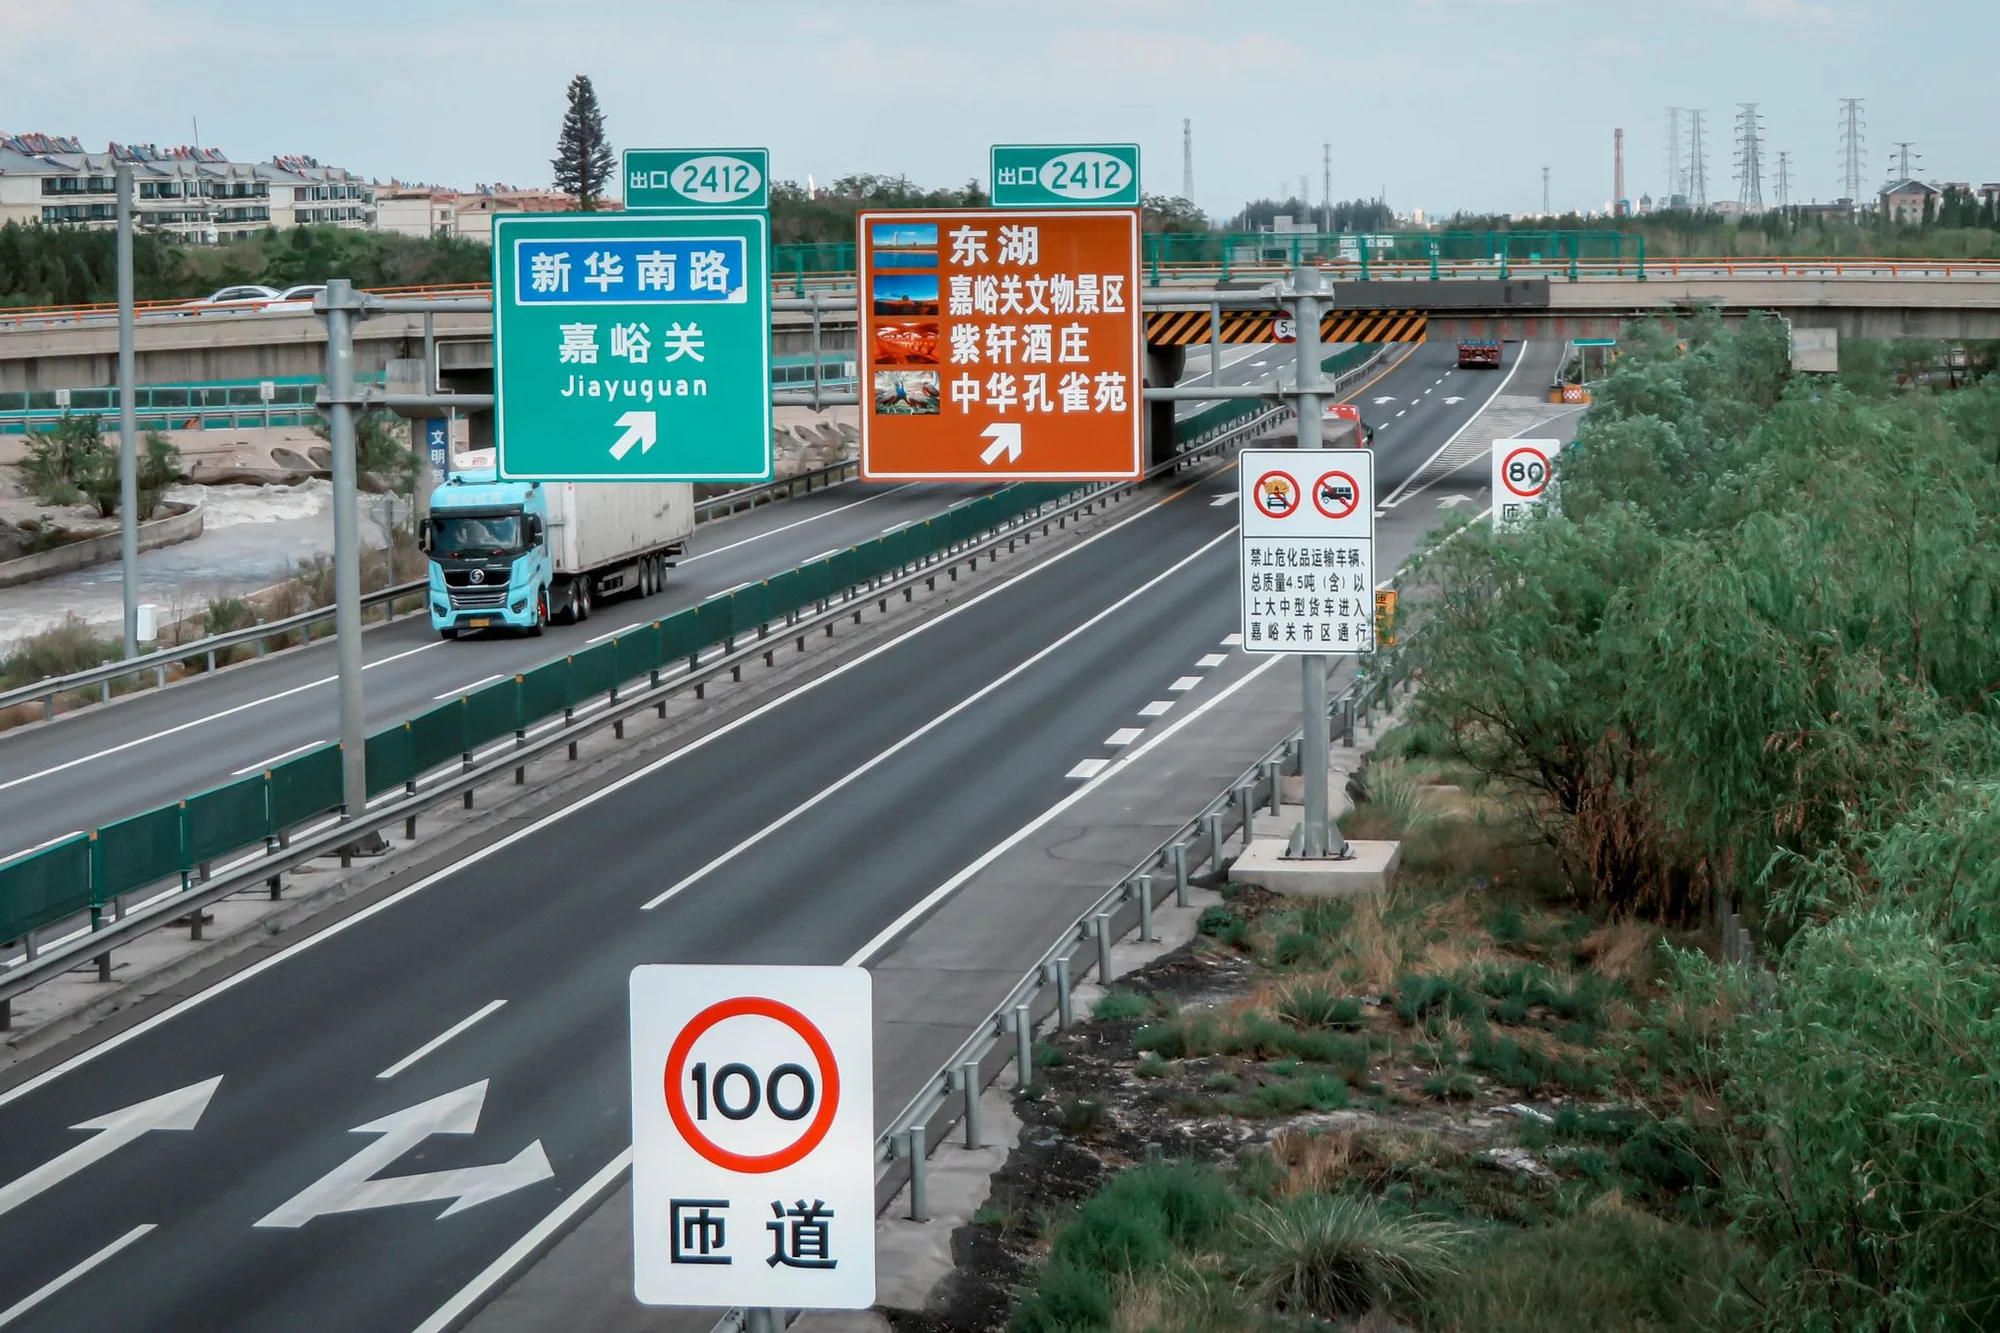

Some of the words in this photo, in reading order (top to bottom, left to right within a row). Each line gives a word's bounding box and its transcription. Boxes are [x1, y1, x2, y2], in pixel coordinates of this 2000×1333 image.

[630, 170, 668, 189] 出口
[682, 165, 750, 193] 2412
[998, 167, 1037, 185] 出口
[1052, 160, 1121, 189] 2412
[949, 224, 1038, 266] 东湖
[531, 250, 730, 293] 新华南路
[949, 273, 1126, 316] 嘉峪关文物景区
[559, 321, 706, 364] 嘉峪关
[950, 322, 1090, 365] 紫轩酒庄
[560, 374, 708, 403] Jiayuguan
[951, 371, 1128, 414] 中华孔雀苑
[1509, 461, 1544, 482] 80
[1250, 547, 1365, 568] 禁止危化品运输车辆、
[1250, 597, 1365, 617] 上大中型货车进入
[1250, 622, 1367, 642] 嘉峪关市区通行
[691, 1062, 815, 1121] 100
[670, 1198, 838, 1270] 匝道
